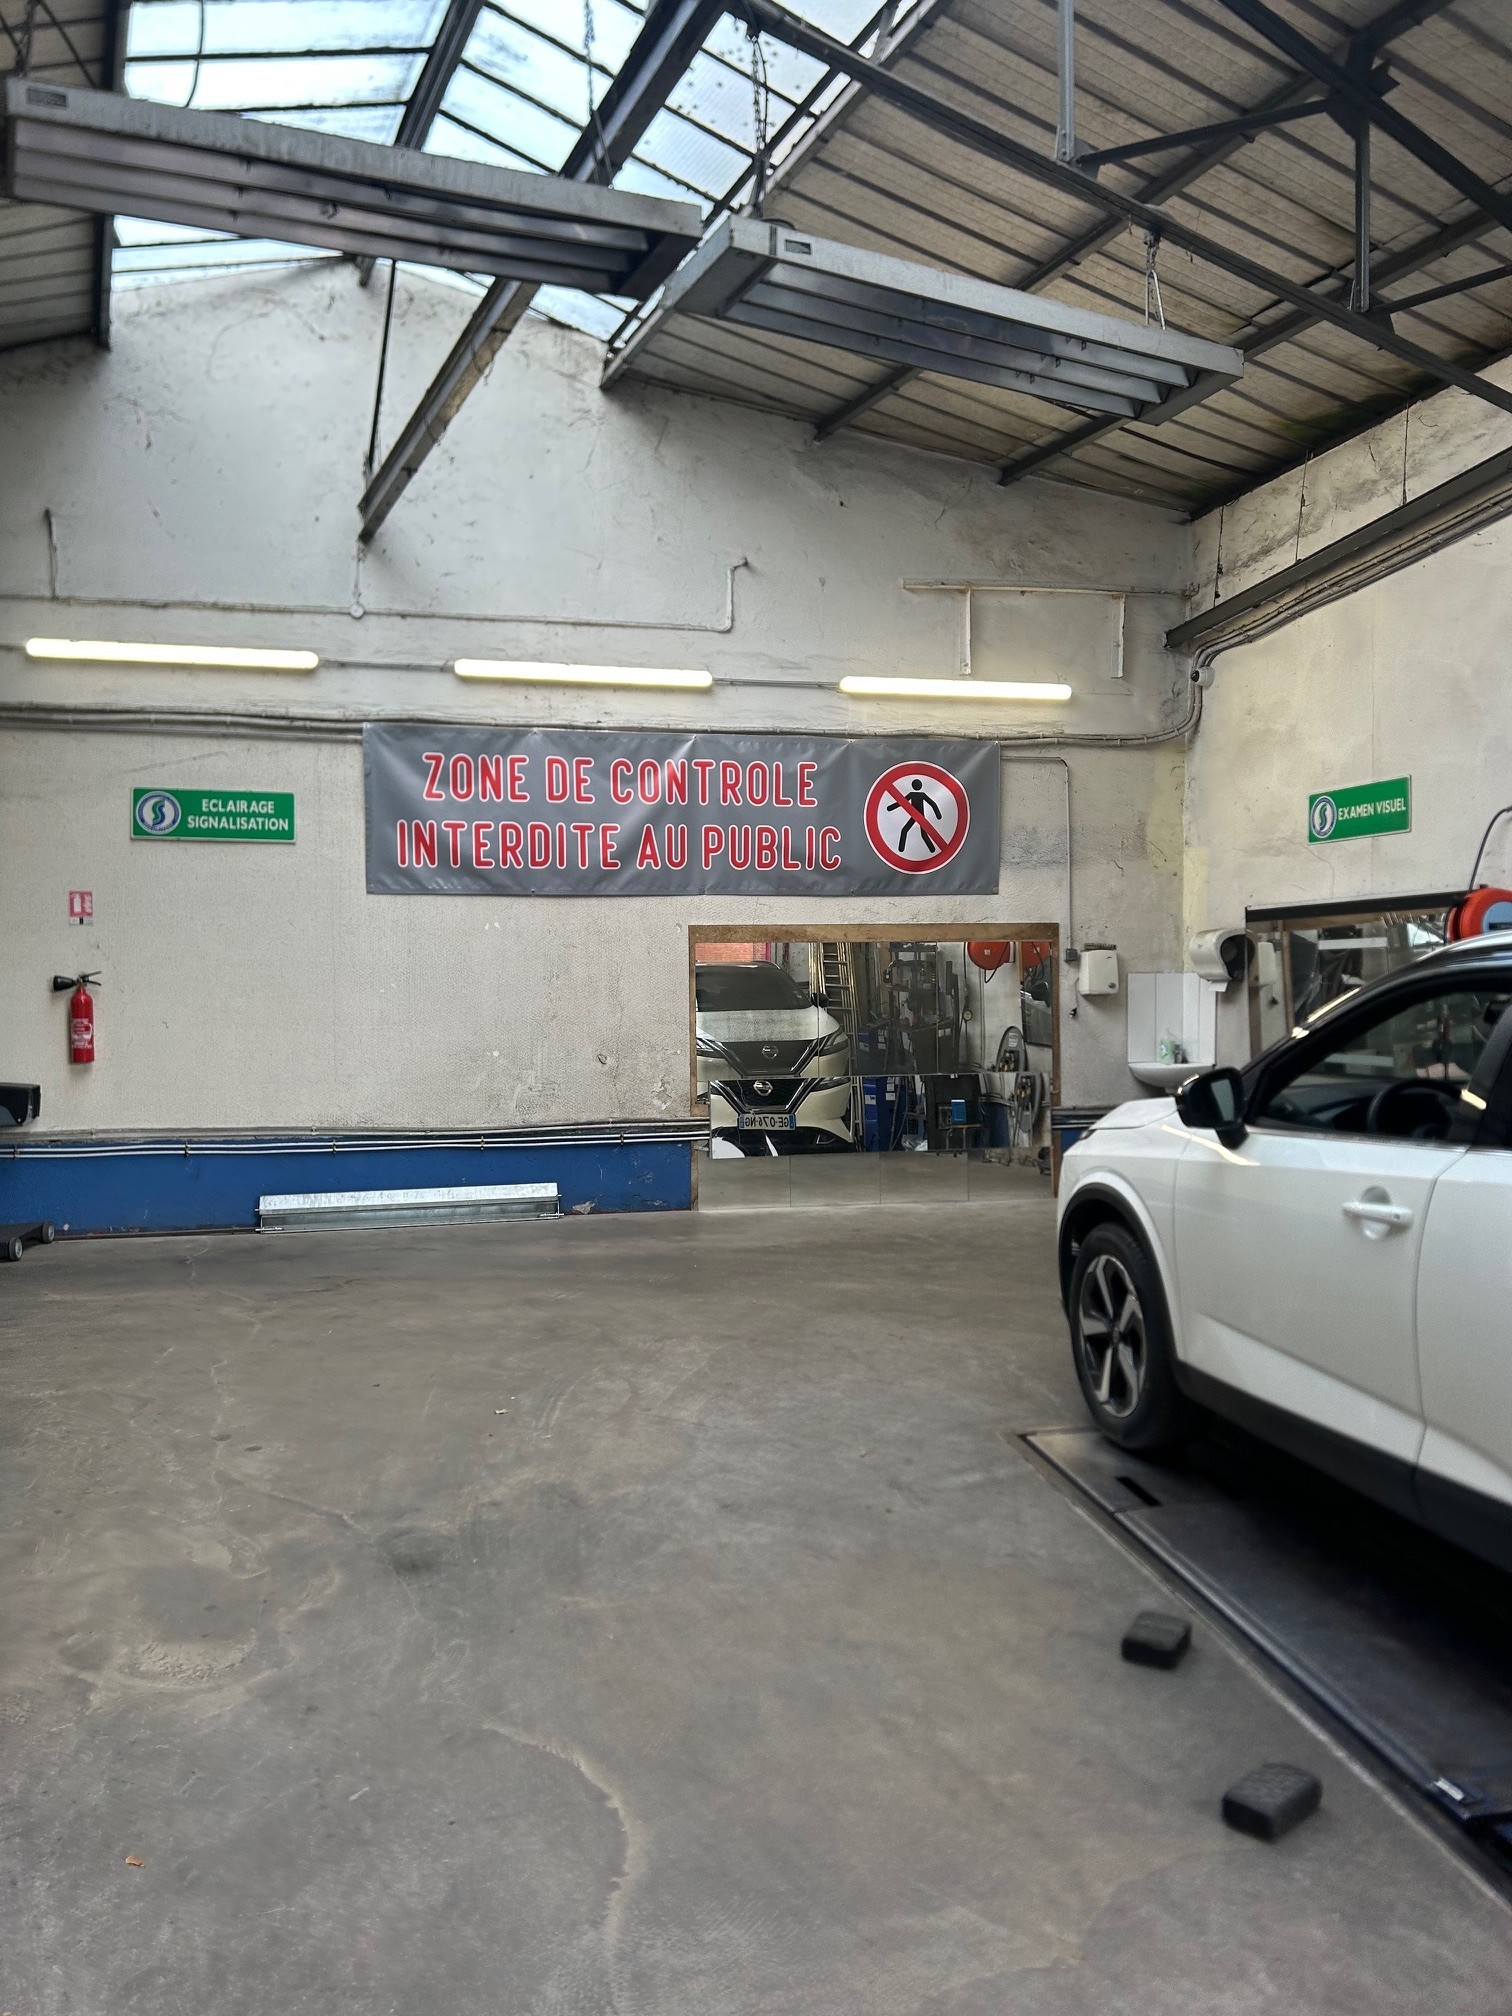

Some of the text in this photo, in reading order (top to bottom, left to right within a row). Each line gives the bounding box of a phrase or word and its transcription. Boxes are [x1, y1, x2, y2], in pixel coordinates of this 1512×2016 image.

[422, 753, 818, 807] ZONE DE CONTROLE
[201, 798, 275, 814] ECLAIRAGE
[1338, 803, 1375, 820] EXAMEN
[1376, 797, 1406, 814] VISUEL
[187, 816, 289, 831] SIGNALISATION
[396, 819, 842, 871] INTERDITE AU PUBLIC
